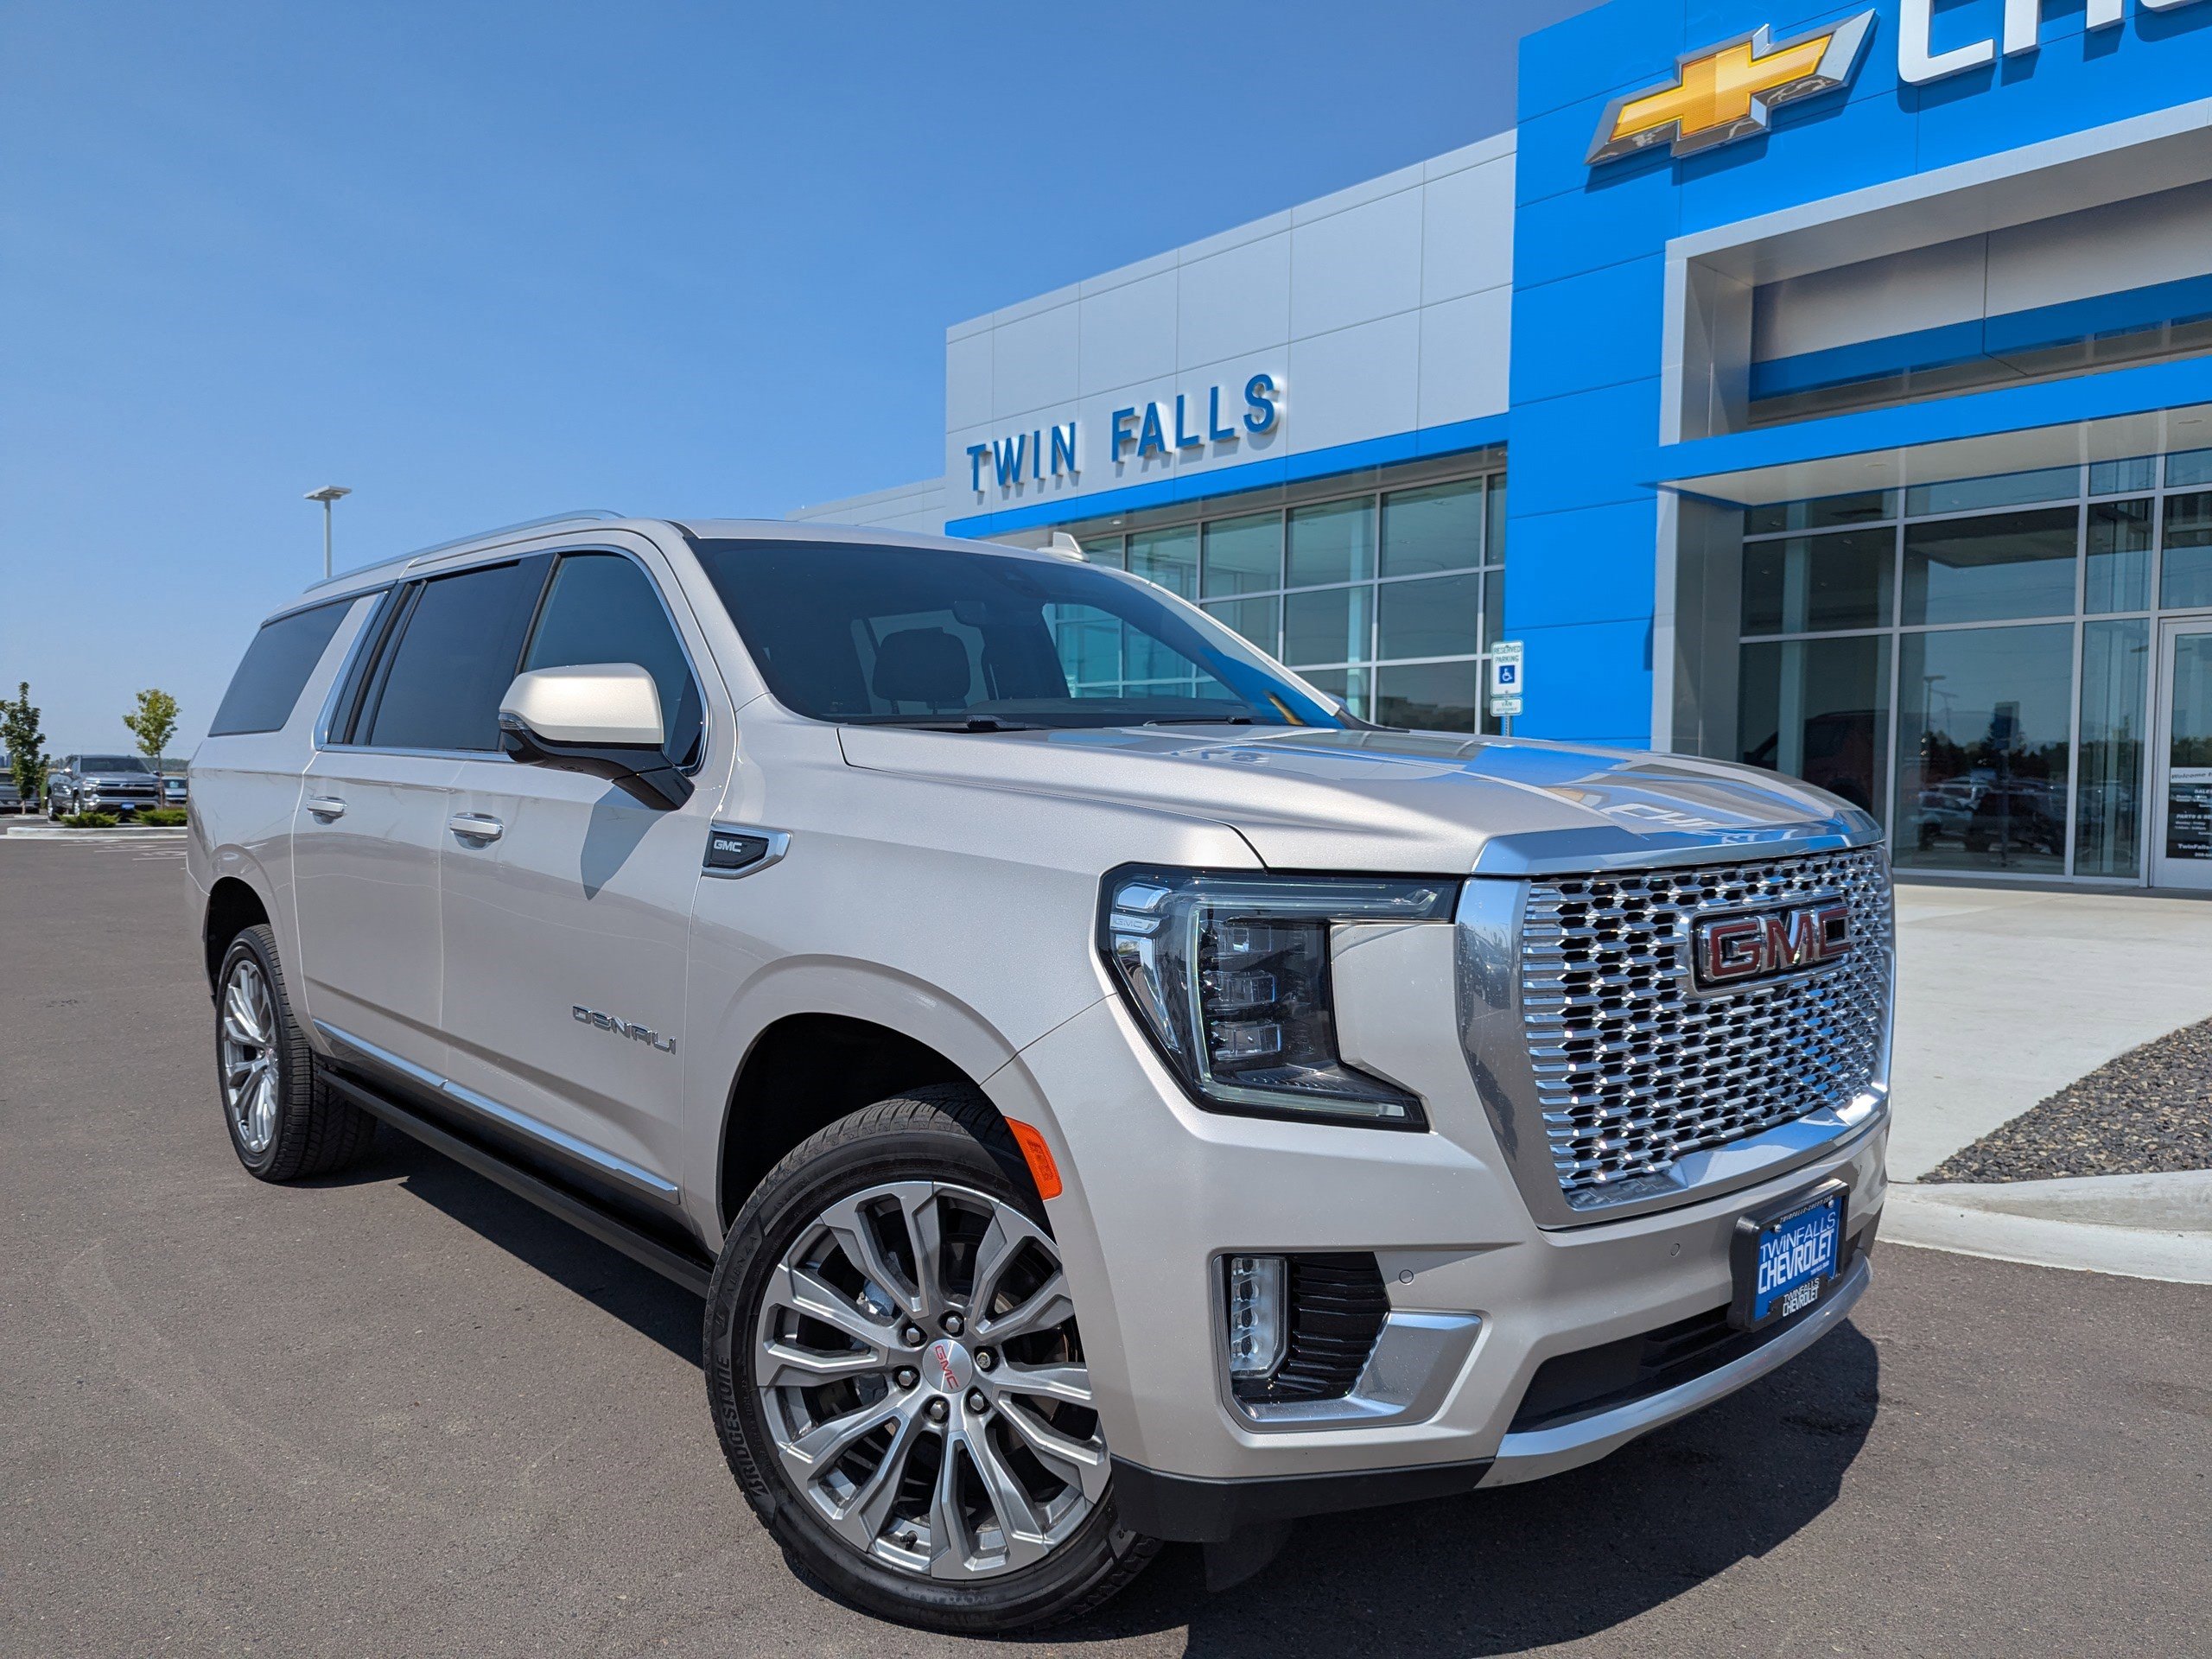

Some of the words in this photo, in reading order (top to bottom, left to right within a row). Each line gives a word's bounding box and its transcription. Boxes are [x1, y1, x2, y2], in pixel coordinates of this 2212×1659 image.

[966, 422, 1079, 493] TWIN
[1111, 373, 1278, 463] FALLS
[1493, 645, 1522, 655] RESERVED
[1495, 655, 1520, 664] PARKING
[713, 838, 743, 854] GMC
[1114, 917, 1143, 929] GMC
[1706, 906, 1851, 979] GMC
[572, 1002, 677, 1055] DENALI
[1758, 1229, 1834, 1294] CHEVROLET
[1783, 1287, 1820, 1318] CHEVROLET
[935, 1344, 959, 1389] GMC
[716, 1354, 770, 1497] BRIDGESTONE
